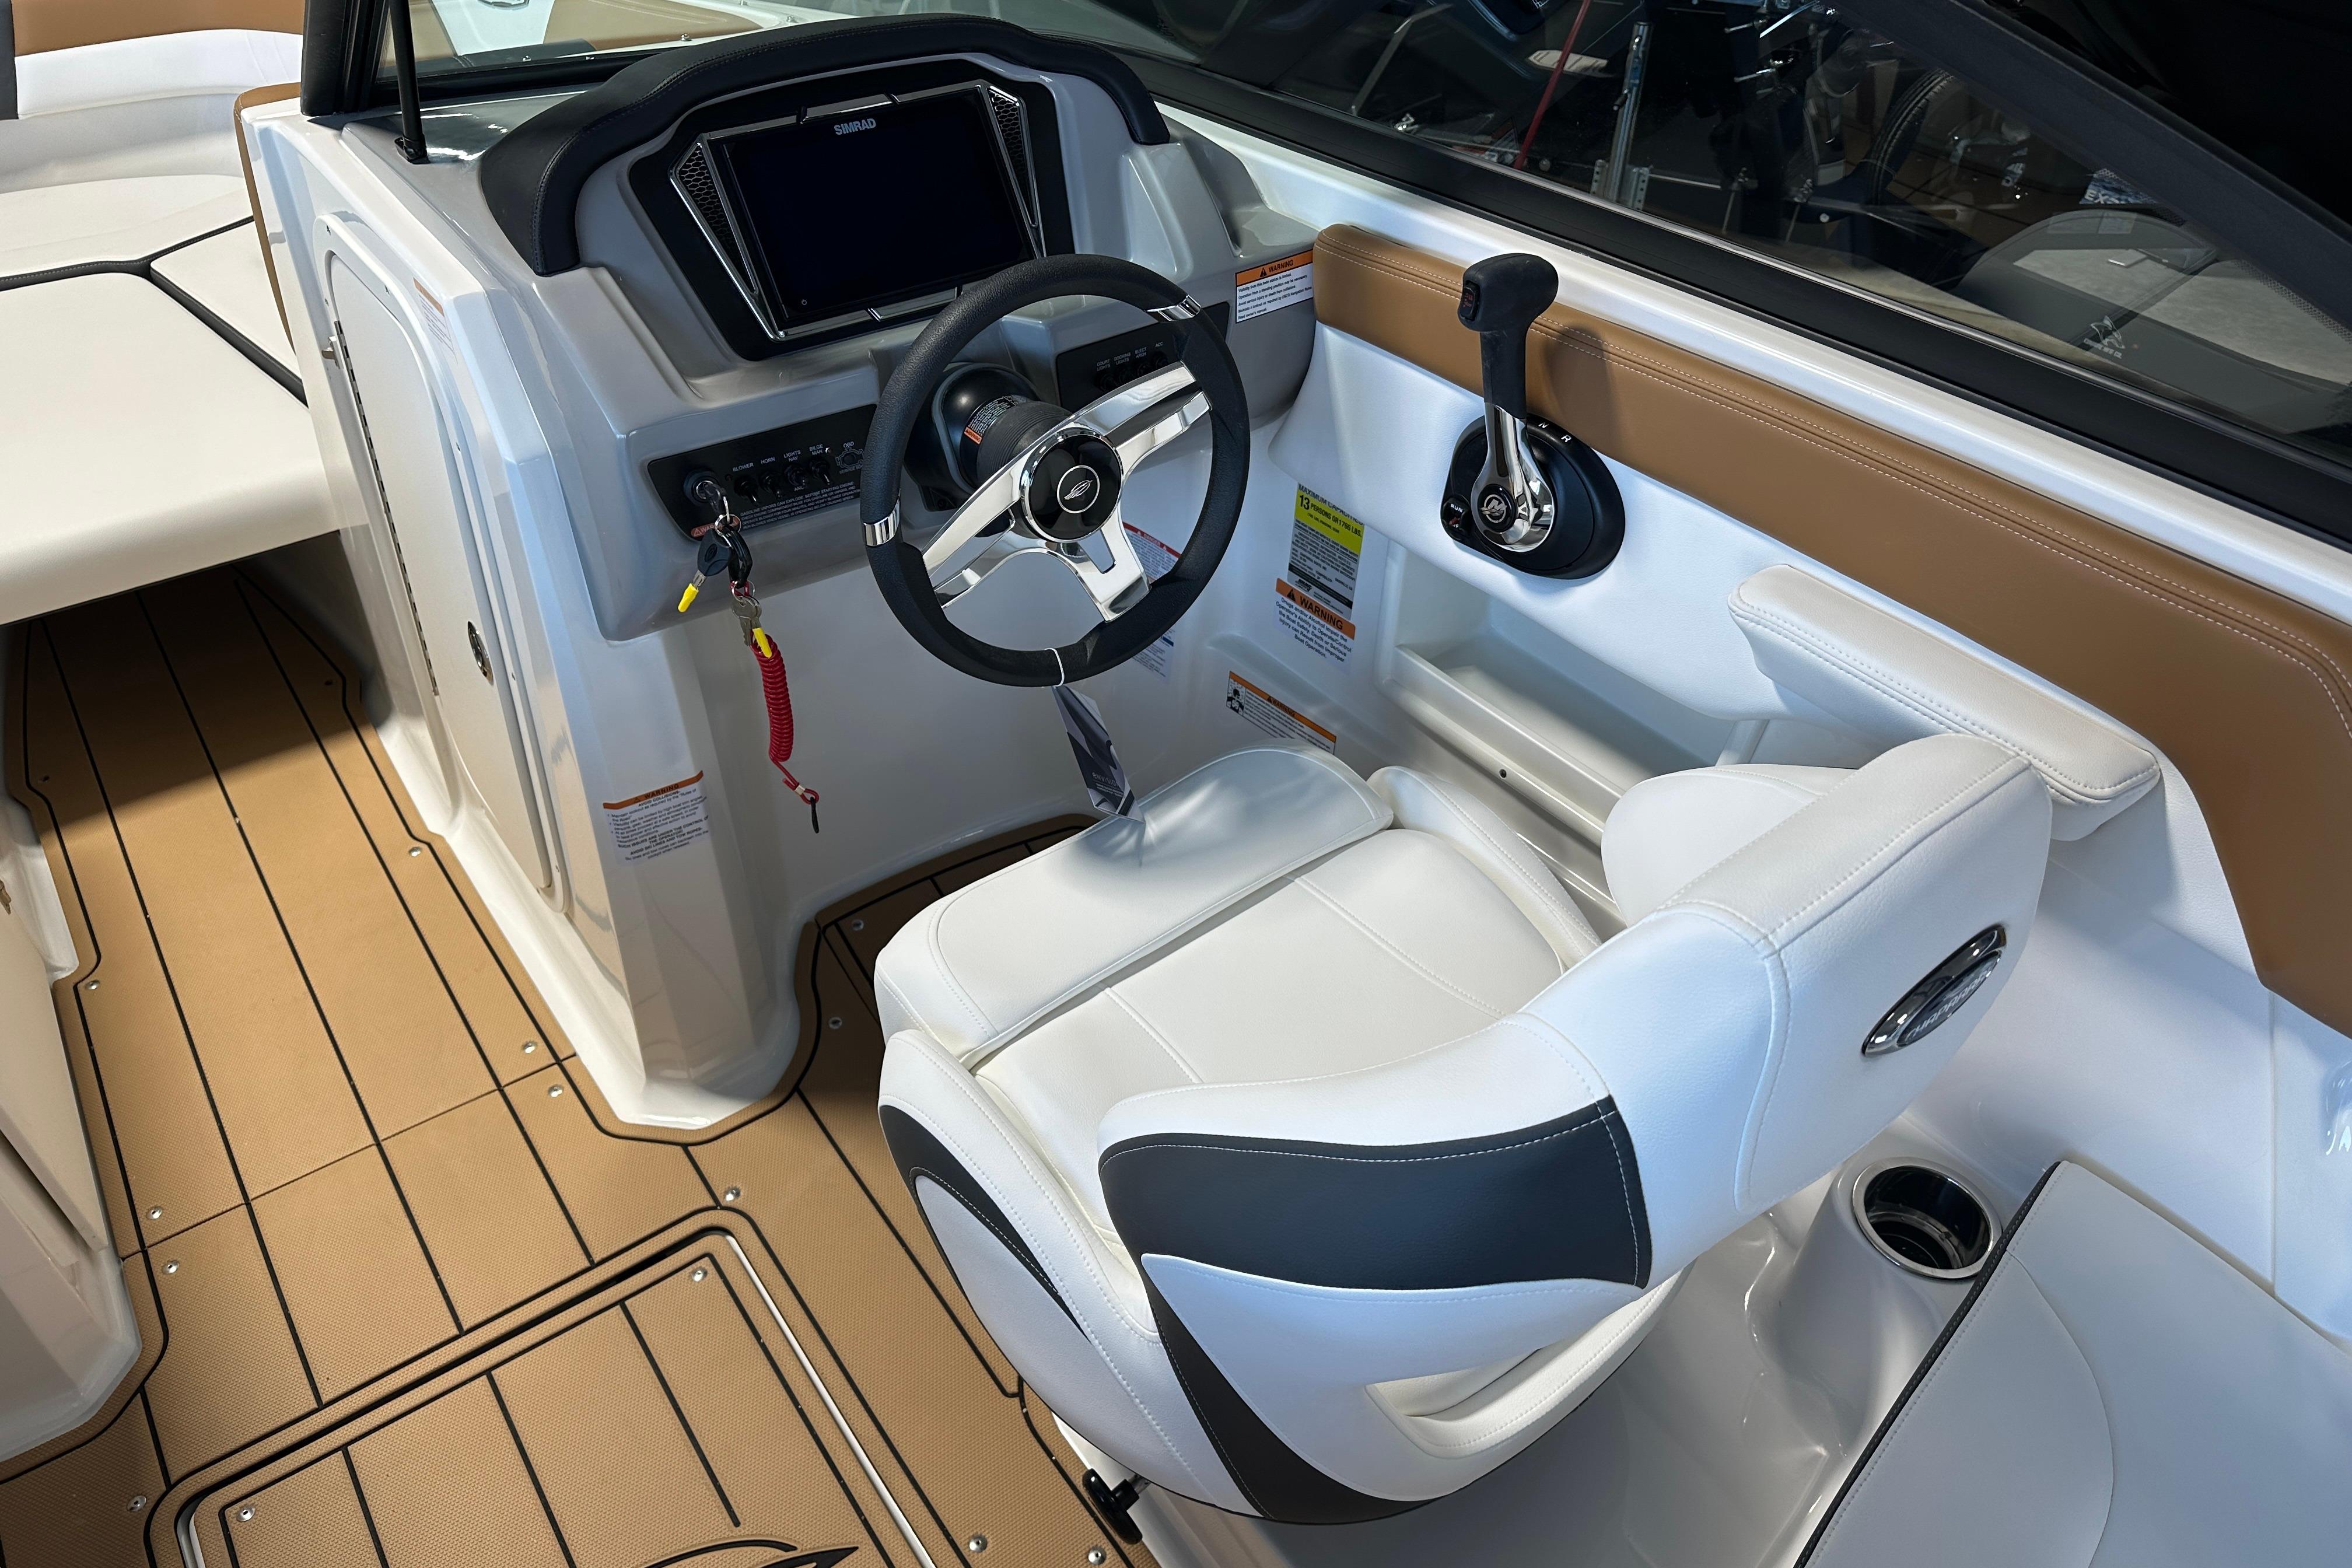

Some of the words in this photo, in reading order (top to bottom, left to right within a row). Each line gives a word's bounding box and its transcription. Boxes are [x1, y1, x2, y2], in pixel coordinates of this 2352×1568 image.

[834, 118, 876, 135] SIMRAD
[1269, 260, 1293, 272] WARNING
[761, 457, 775, 465] HORN
[783, 450, 801, 459] LIGHTS
[733, 463, 754, 472] BLOWER
[1298, 484, 1327, 505] MAXIMUM
[740, 508, 760, 516] GASOLINE
[1300, 495, 1310, 510] 13
[1311, 503, 1331, 520] PERSONS
[1332, 516, 1339, 524] OR
[1351, 526, 1362, 537] LBS.
[1450, 503, 1463, 513] RUN
[1281, 597, 1293, 608] Drugs
[1325, 626, 1339, 637] Impair
[1300, 597, 1342, 629] WARNING
[1297, 615, 1311, 628] Ability
[1279, 617, 1291, 628] Injury
[1300, 631, 1313, 642] Result
[1314, 639, 1324, 649] from
[1325, 647, 1344, 662] Improper
[1286, 614, 1296, 624] Boat
[1311, 631, 1323, 642] Death
[1330, 643, 1346, 656] Serious
[1294, 634, 1304, 643] Boat
[1305, 641, 1326, 657] Operation.
[644, 784, 679, 799] WARNING
